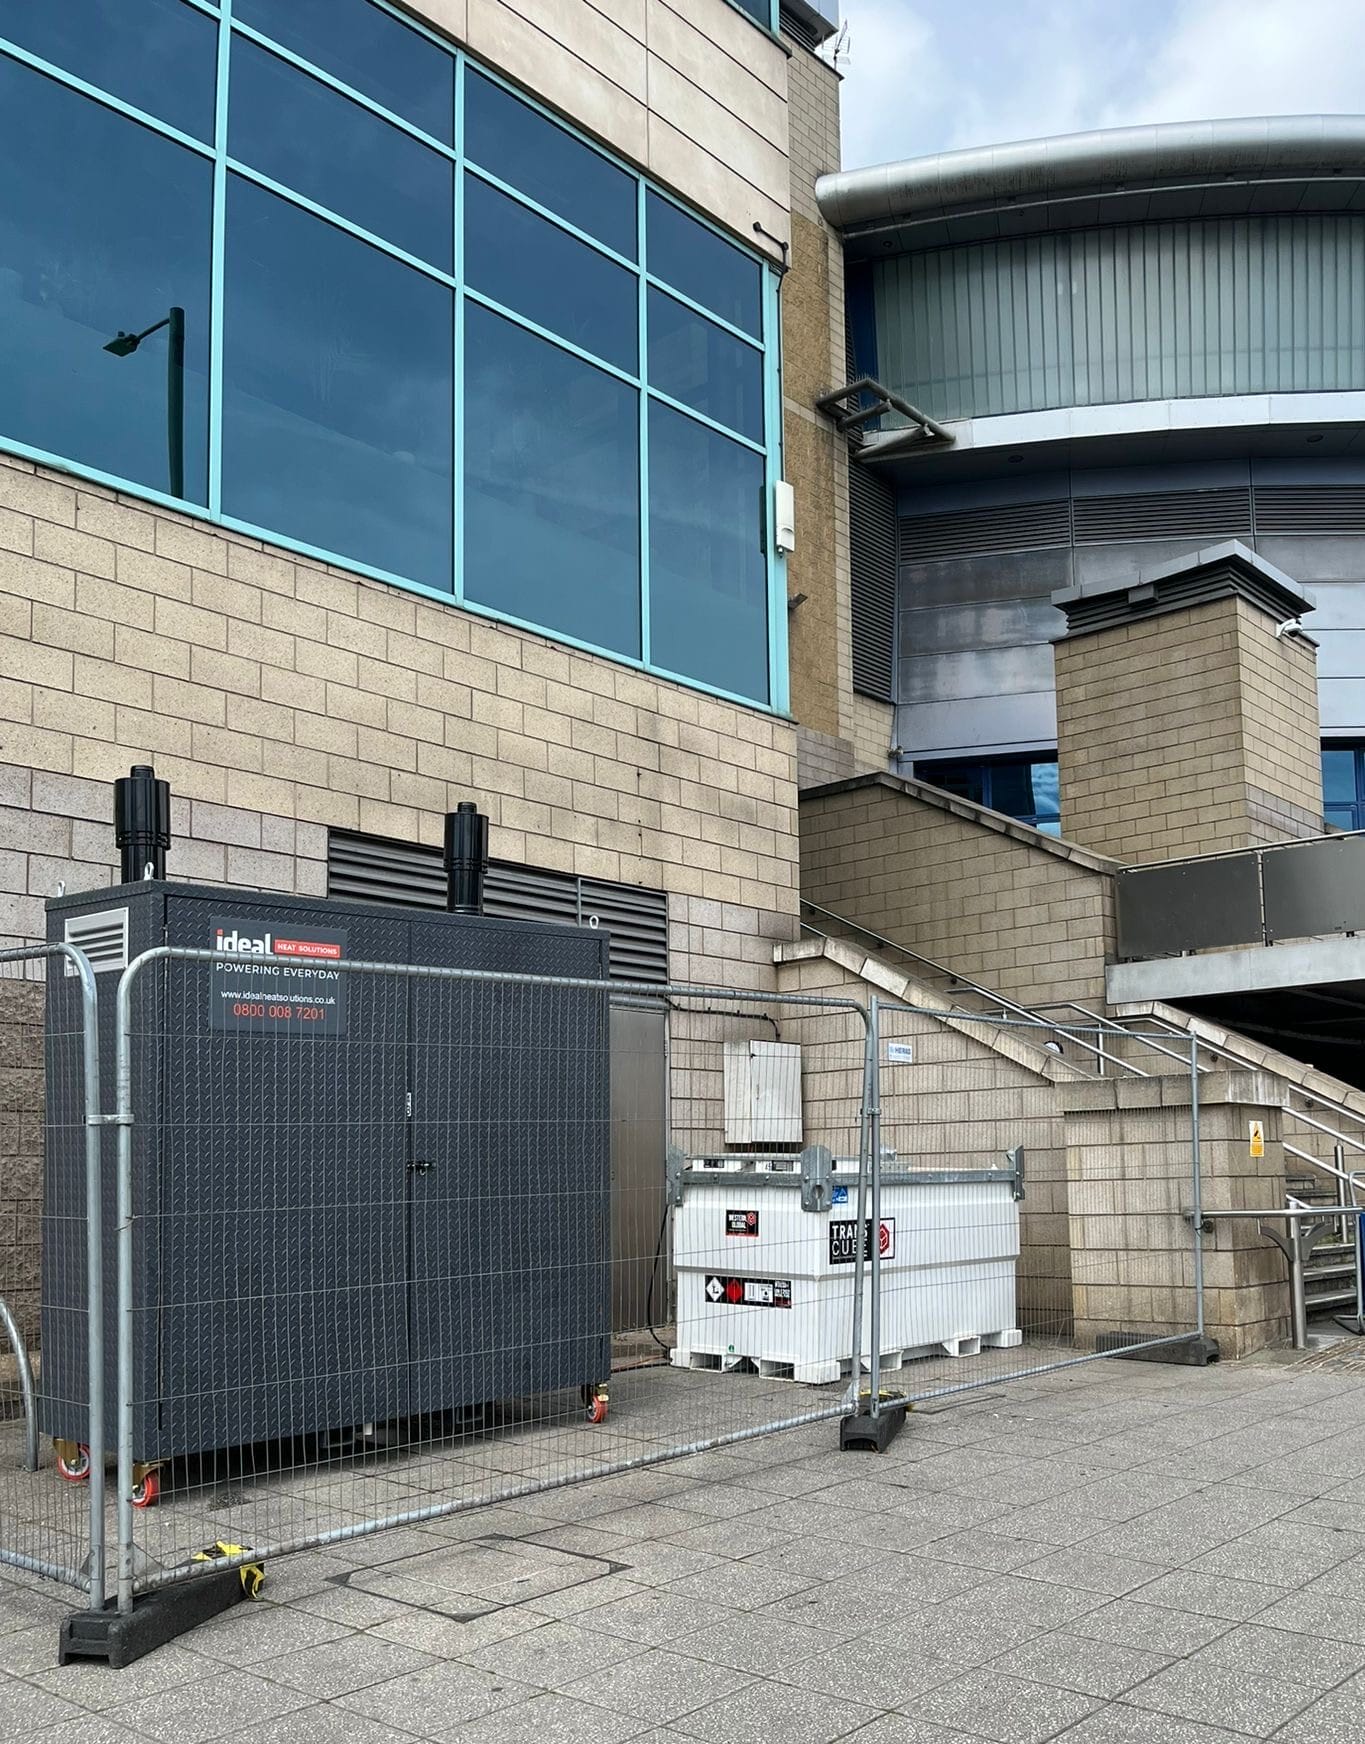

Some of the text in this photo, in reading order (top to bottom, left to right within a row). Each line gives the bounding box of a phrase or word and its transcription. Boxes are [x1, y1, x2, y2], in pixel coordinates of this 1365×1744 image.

[216, 928, 274, 955] ideal
[277, 944, 338, 955] HEAT SOLUTIONS
[216, 962, 340, 980] POWERING EVERYDAY
[221, 990, 336, 1004] www.idealheatsoutions.co.uk
[233, 1003, 326, 1020] 0800 008 7201
